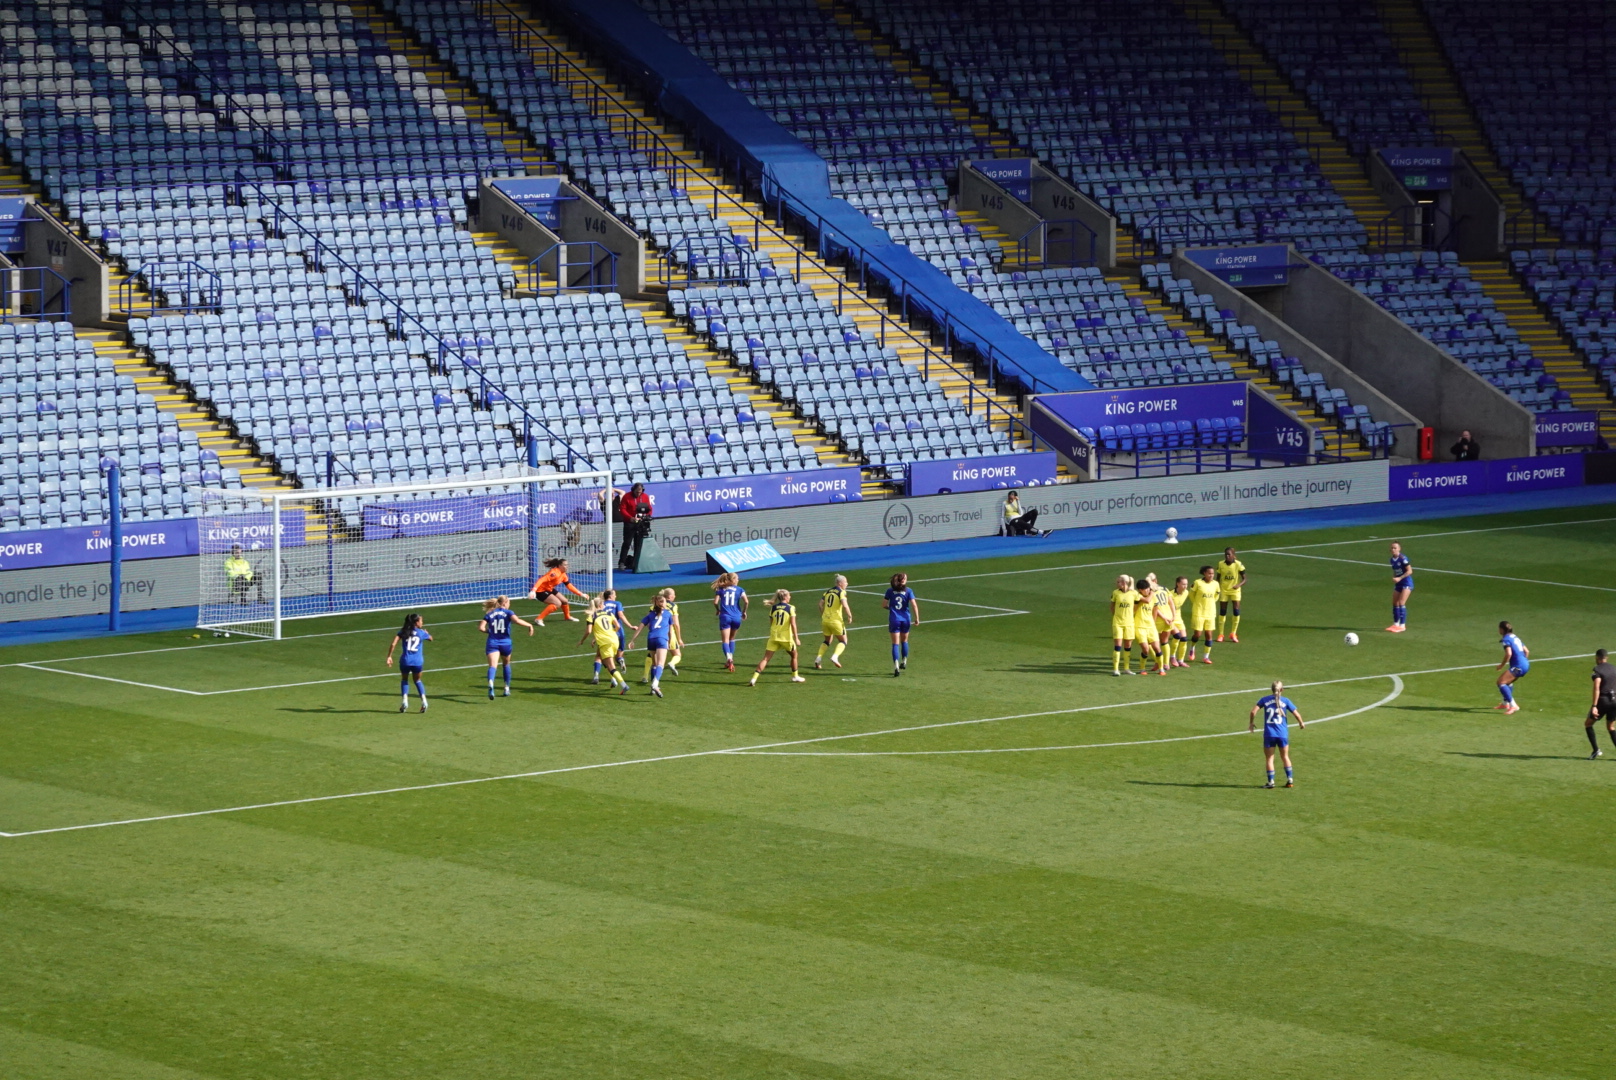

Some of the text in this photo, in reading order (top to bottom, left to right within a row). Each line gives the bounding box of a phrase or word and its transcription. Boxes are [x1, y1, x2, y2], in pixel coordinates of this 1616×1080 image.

[1391, 158, 1442, 166] KING POWER
[998, 169, 1023, 178] POWER
[981, 194, 1004, 210] V45
[1052, 194, 1075, 210] V45
[502, 214, 523, 232] V46
[585, 217, 606, 234] V46
[47, 239, 68, 257] V47
[1215, 255, 1257, 265] KING POWER
[1105, 399, 1178, 416] KING POWER
[1535, 421, 1596, 434] KING POWER
[1275, 427, 1303, 447] V45
[1072, 446, 1087, 458] V45
[953, 465, 1016, 481] KING POWER
[1506, 466, 1566, 482] KING POWER
[780, 479, 847, 495] KING POWER
[1408, 474, 1468, 489] KING POWER
[684, 487, 752, 503] KING POWER
[1053, 502, 1070, 515] on
[1074, 499, 1103, 517] your
[1107, 492, 1197, 513] performance,
[1201, 485, 1230, 502] we'll
[1234, 482, 1278, 500] handle
[1281, 480, 1303, 496] the
[1305, 479, 1352, 498] journey
[381, 510, 454, 526] KING POWER
[484, 506, 514, 518] KING
[888, 508, 983, 528] ATPI Sports Travel
[122, 533, 166, 547] POWER
[208, 527, 240, 541] KING
[662, 530, 714, 548] handle
[718, 528, 742, 544] the
[746, 525, 800, 542] journey
[0, 542, 43, 557] POWER
[725, 543, 778, 566] BARCLAYS
[452, 552, 471, 566] on
[59, 580, 87, 599] the
[92, 579, 156, 601] jorney
[723, 591, 736, 606] 11
[827, 594, 835, 608] 9
[894, 596, 903, 610] 3
[491, 618, 506, 634] 14
[654, 615, 663, 629] 2
[774, 611, 785, 626] 11
[405, 636, 421, 652] 12
[1266, 707, 1284, 725] 23
